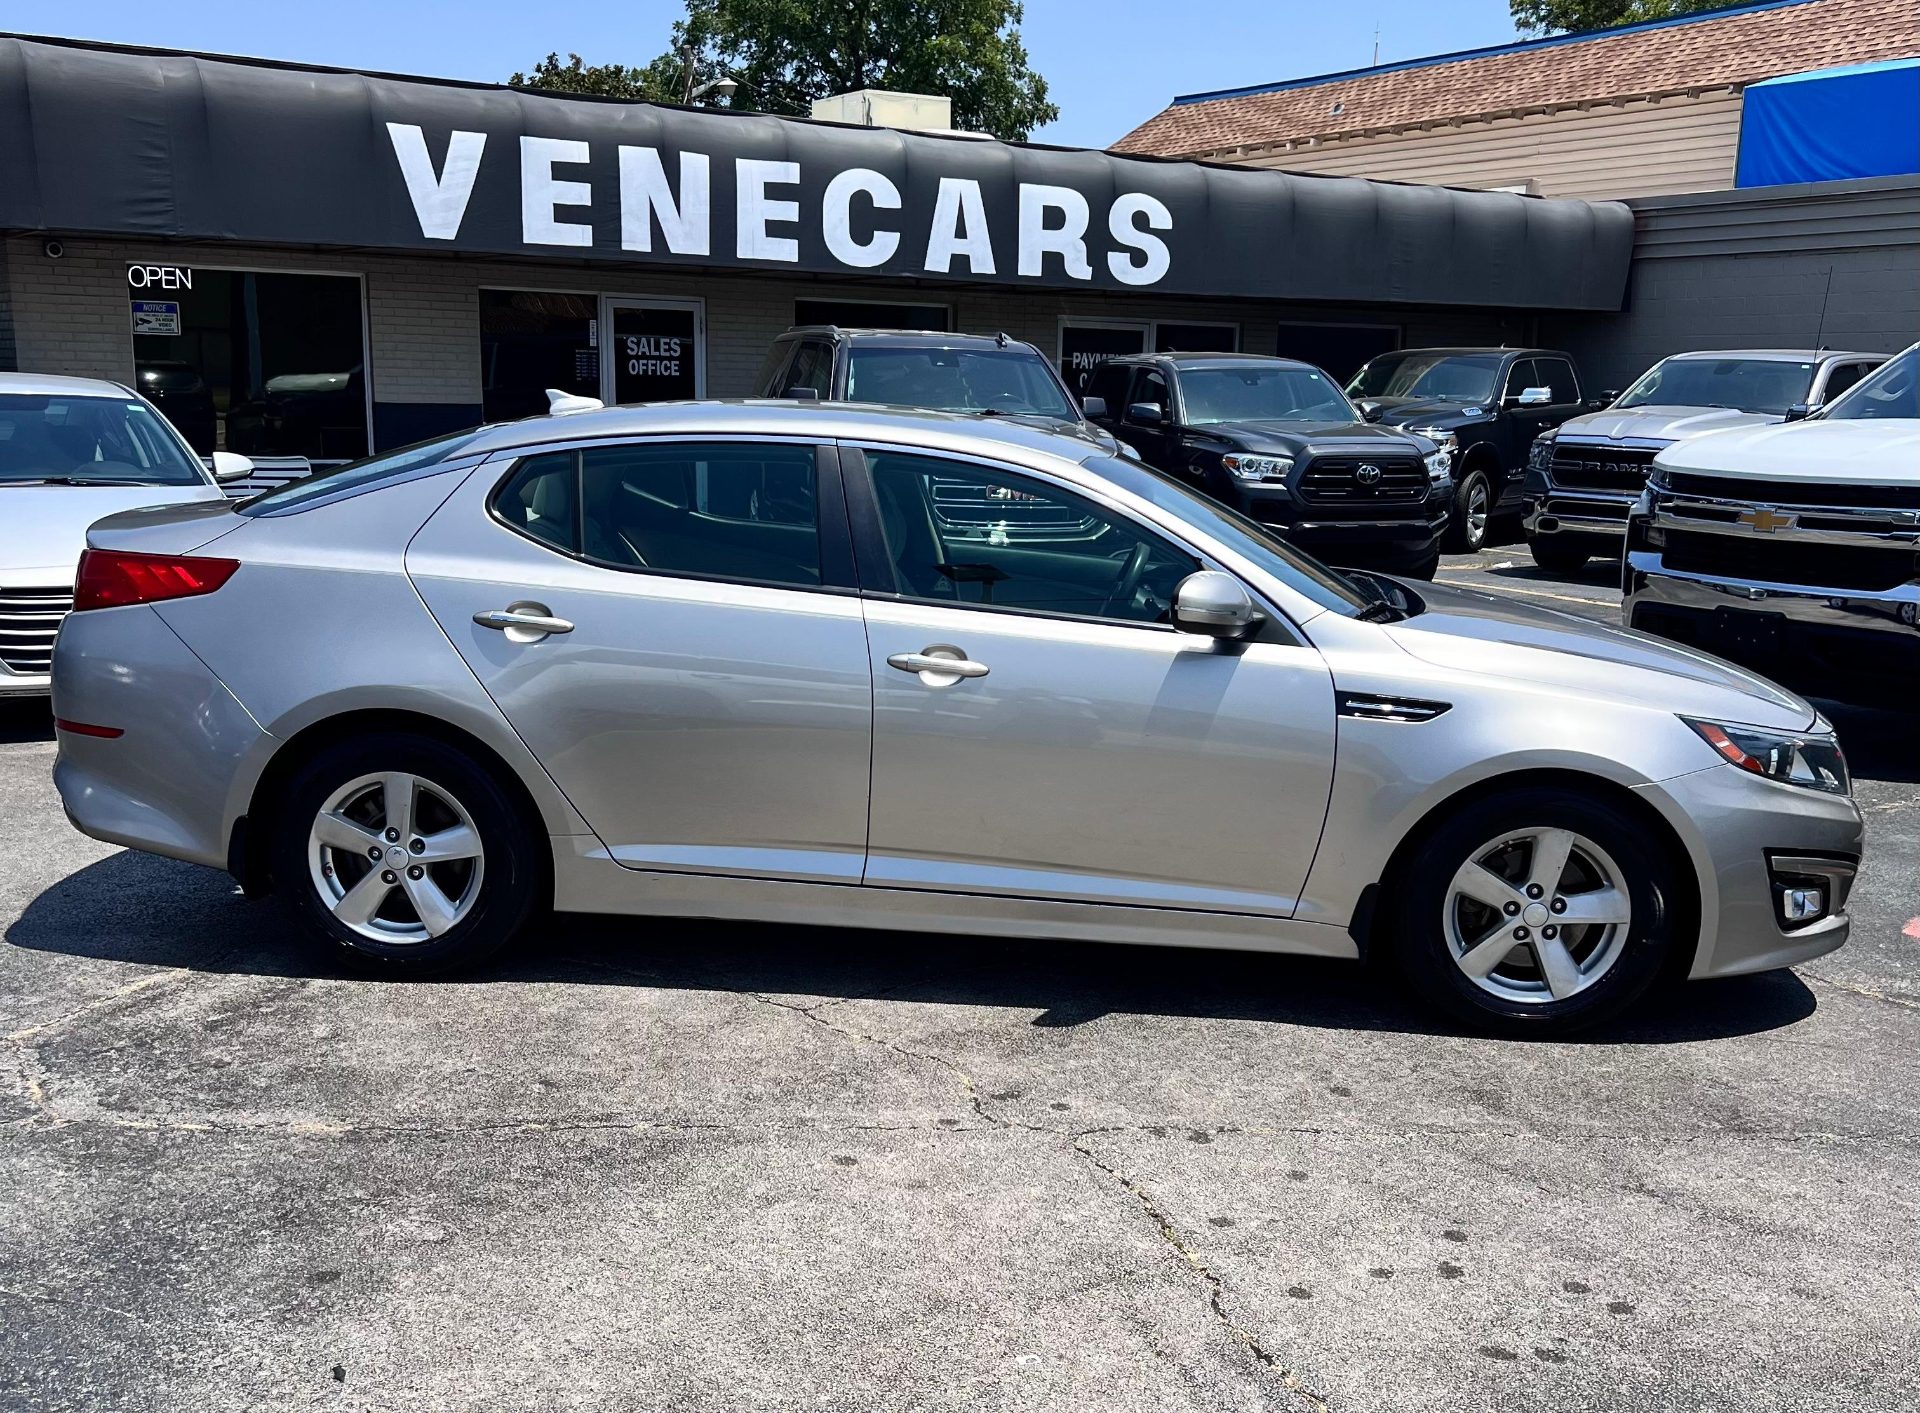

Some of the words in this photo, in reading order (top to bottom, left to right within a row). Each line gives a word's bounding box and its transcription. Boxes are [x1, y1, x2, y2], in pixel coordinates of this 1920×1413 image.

[385, 122, 1173, 286] VENECARS
[128, 265, 192, 290] OPEN
[143, 303, 167, 312] NOTICE
[627, 336, 681, 357] SALES
[628, 359, 680, 376] OFFICE
[1583, 461, 1638, 472] RAM
